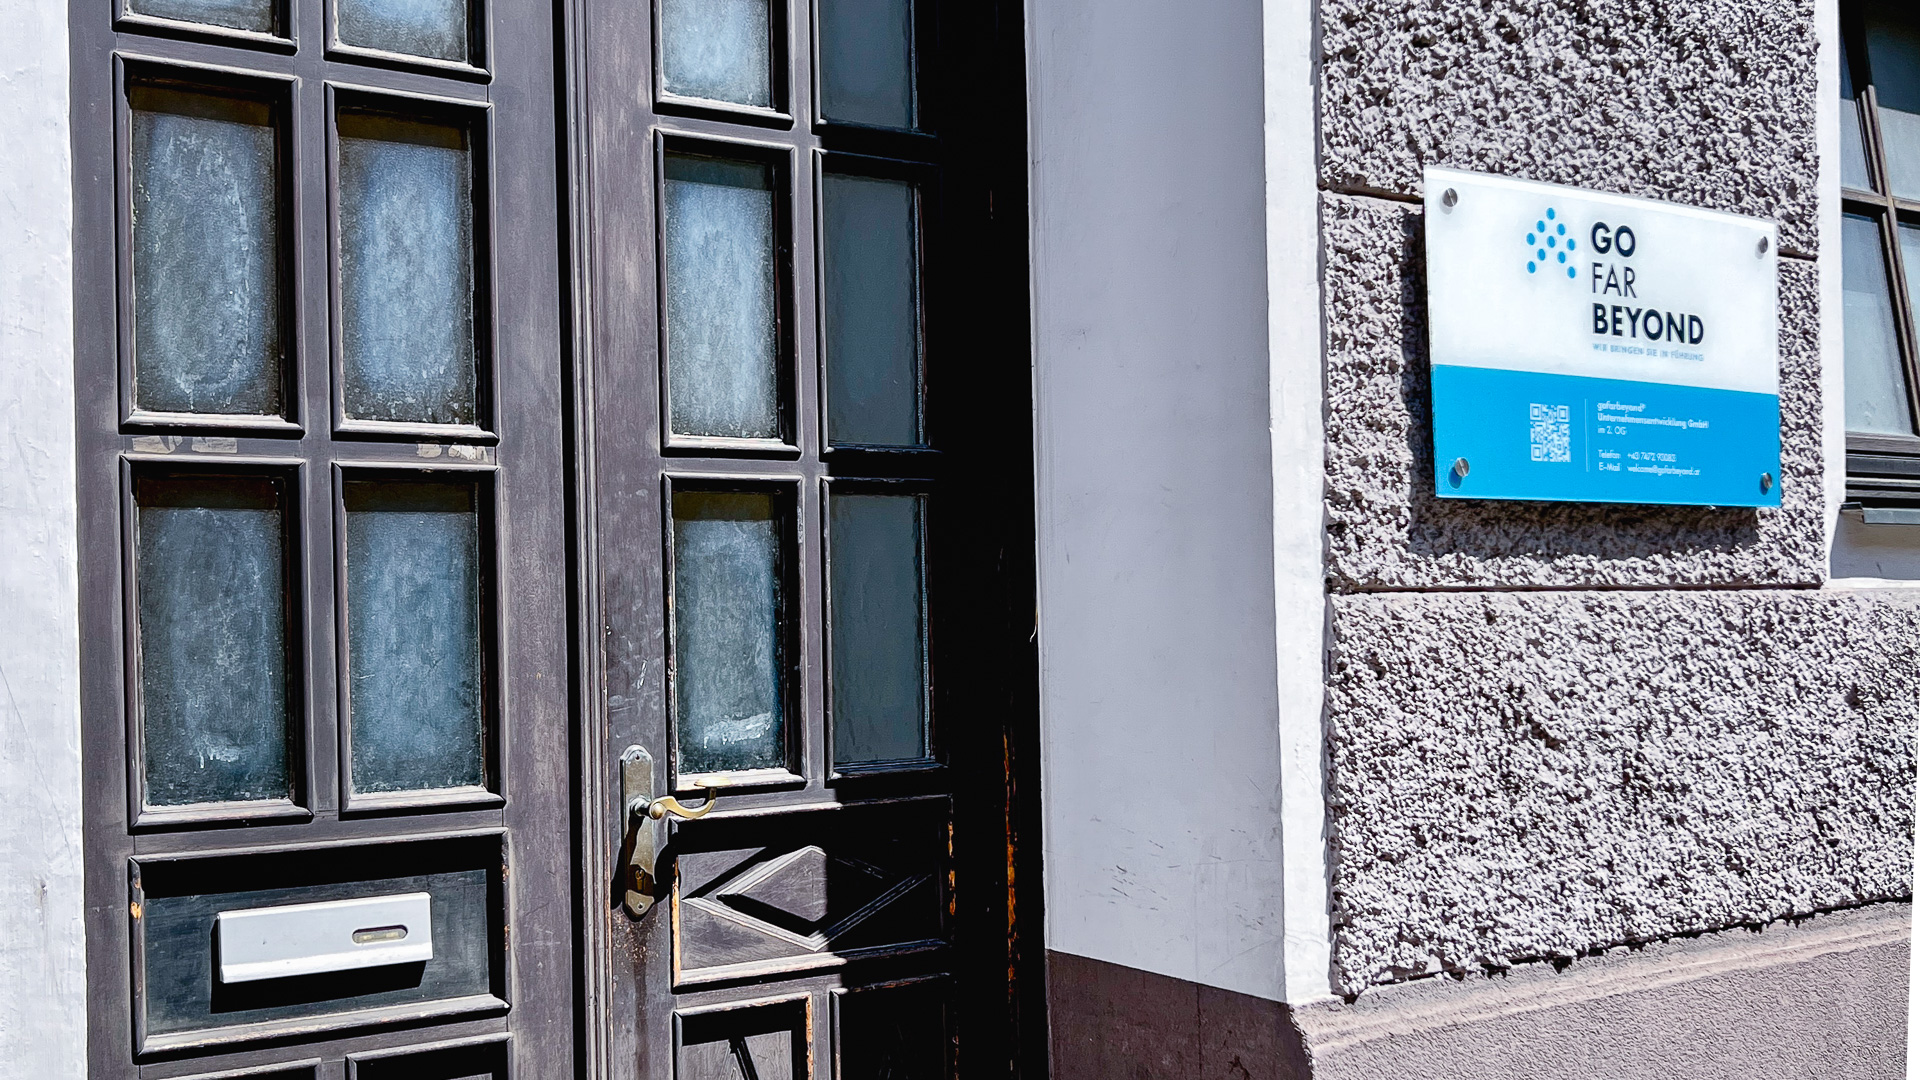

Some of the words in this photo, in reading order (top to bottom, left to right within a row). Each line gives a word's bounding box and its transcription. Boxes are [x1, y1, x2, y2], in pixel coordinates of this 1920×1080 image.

[1591, 221, 1636, 258] GO
[1592, 262, 1637, 299] FAR
[1592, 303, 1705, 345] BEYOND
[1592, 343, 1607, 352] WIR
[1610, 344, 1644, 355] BRINGEN
[1646, 348, 1658, 357] SIE
[1614, 425, 1628, 435] OG
[1687, 418, 1710, 429] GmbH
[1598, 449, 1622, 459] Telefon
